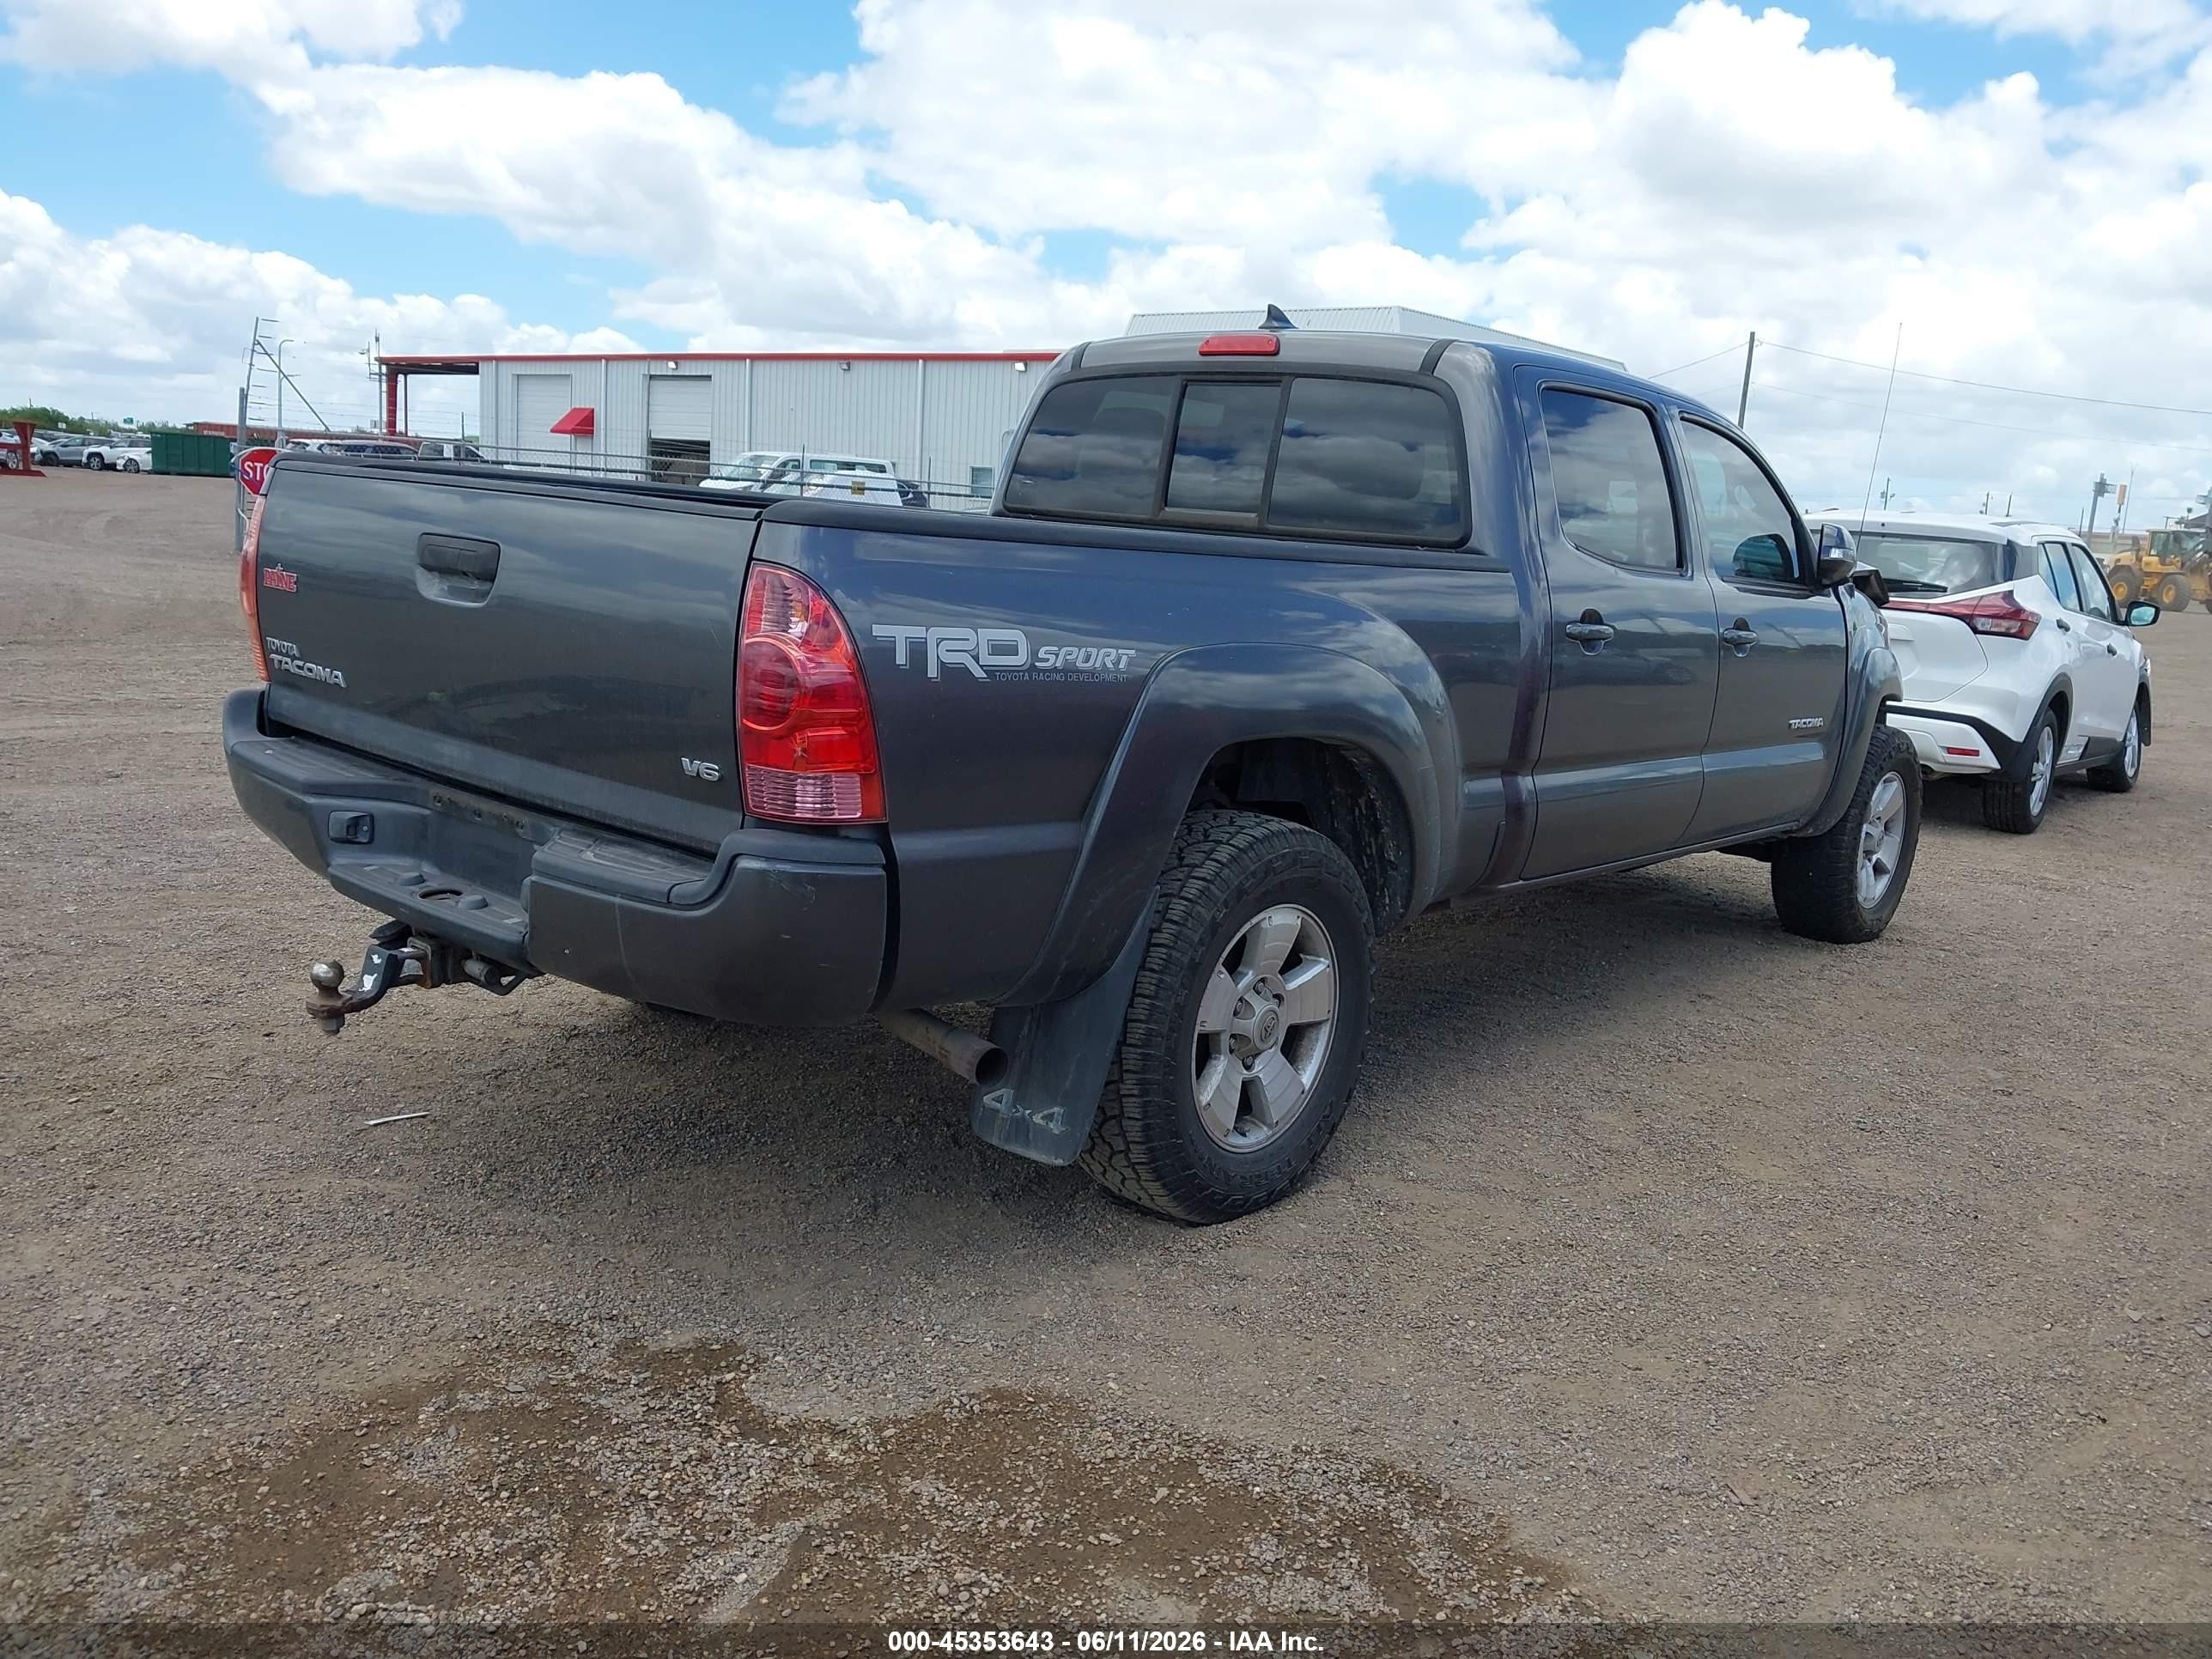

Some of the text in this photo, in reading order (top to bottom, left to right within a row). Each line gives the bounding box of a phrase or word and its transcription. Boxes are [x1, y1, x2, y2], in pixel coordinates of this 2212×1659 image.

[266, 636, 301, 657] TOYOTA
[872, 624, 1137, 681] TRD SPORT
[270, 653, 347, 688] TACOMA
[995, 672, 1127, 683] TOYOTA RACING DEVELOPMENT
[681, 757, 720, 781] V6
